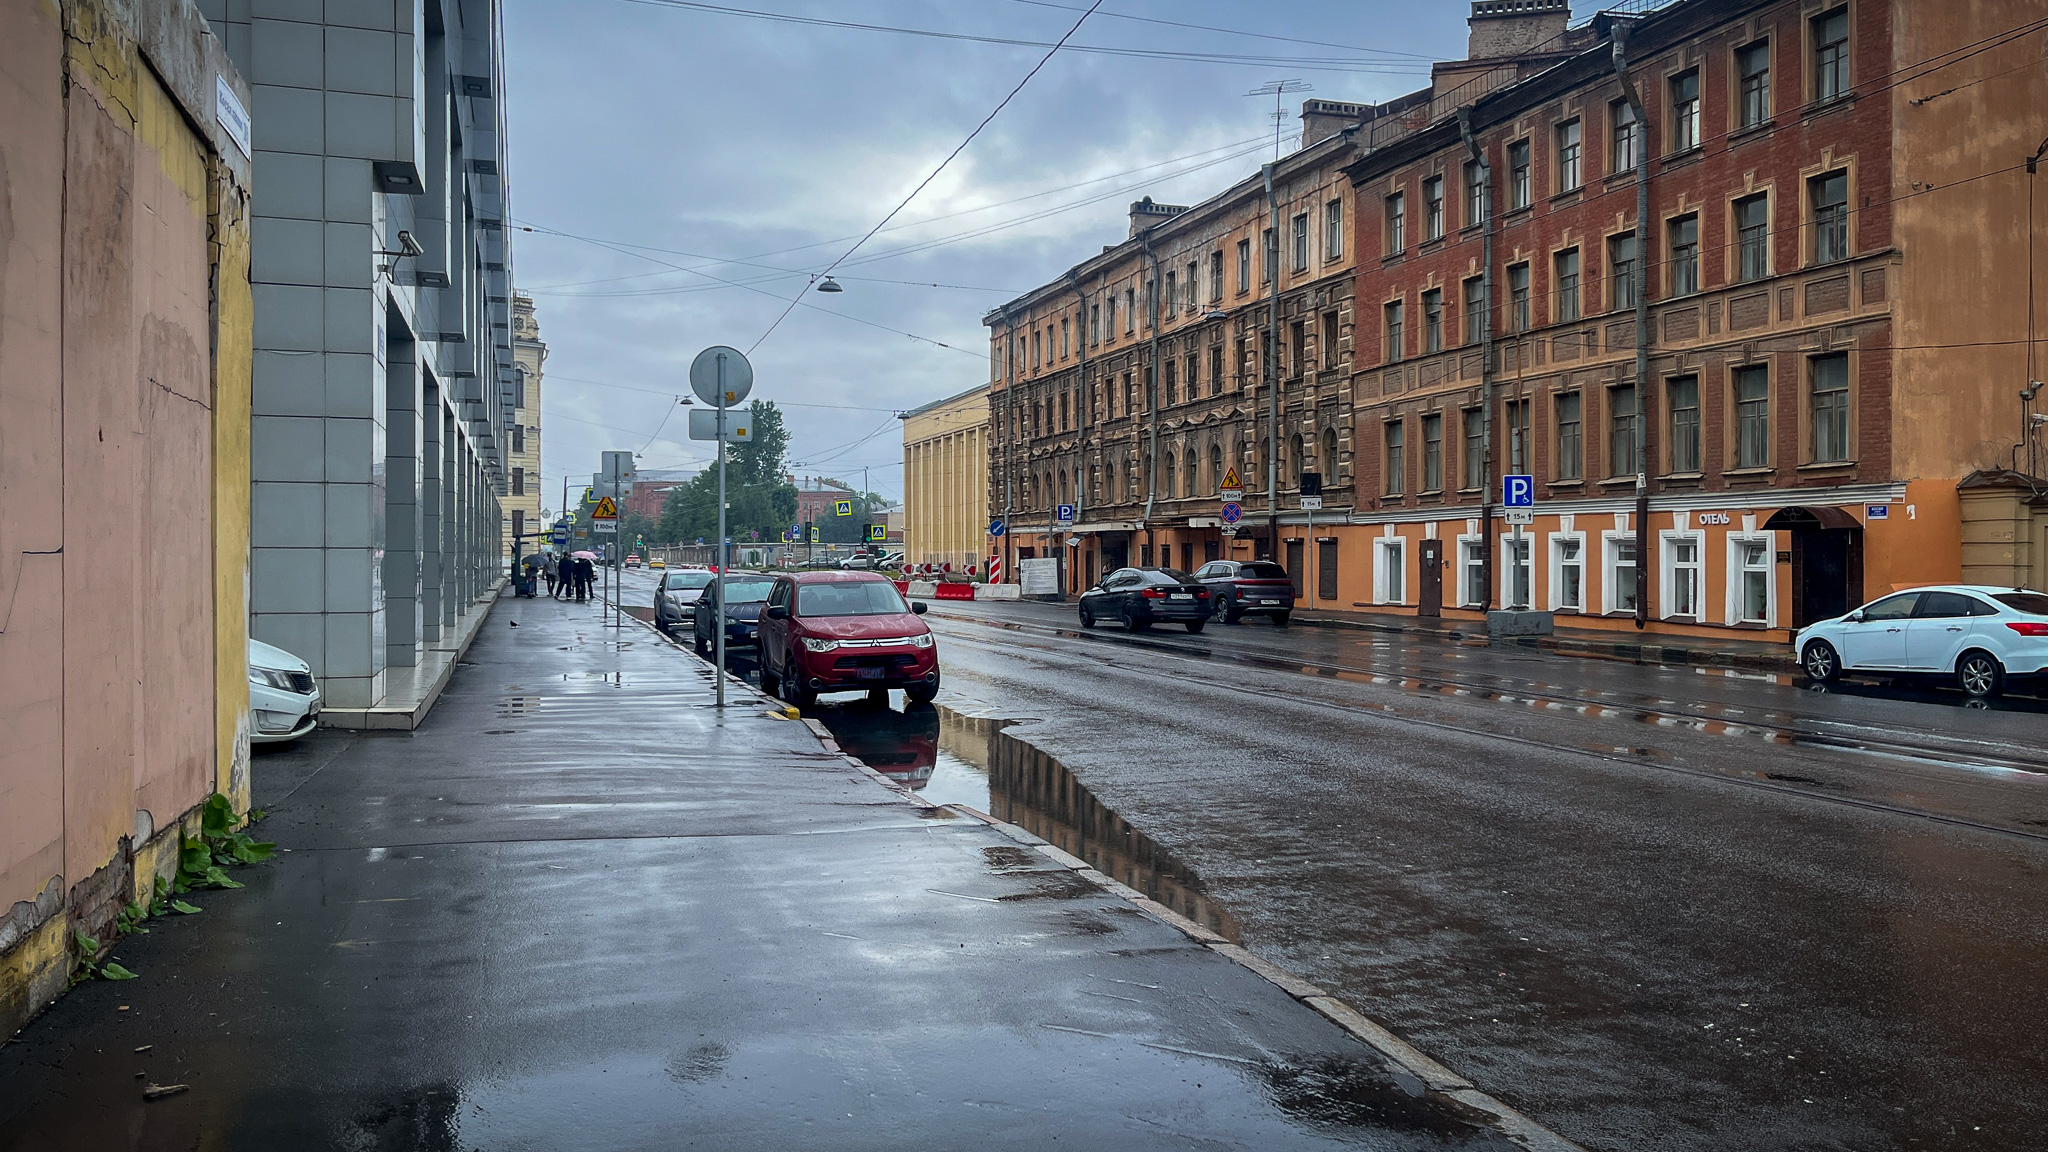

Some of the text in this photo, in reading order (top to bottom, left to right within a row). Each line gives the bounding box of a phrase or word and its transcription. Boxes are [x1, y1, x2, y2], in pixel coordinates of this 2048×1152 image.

[1511, 479, 1528, 504] P
[1061, 506, 1071, 520] P
[1699, 512, 1730, 525] ОТЕЛЬ
